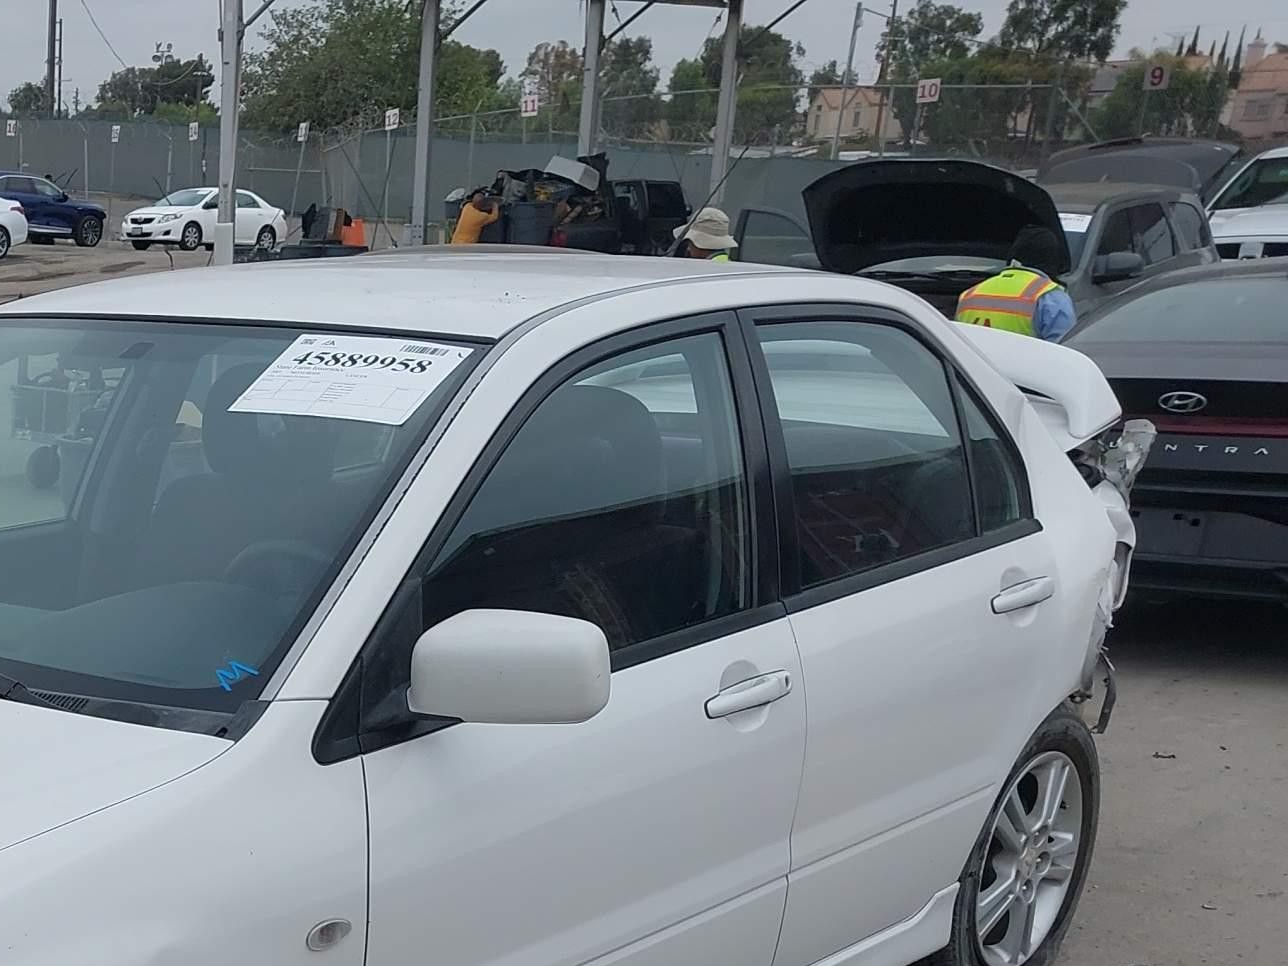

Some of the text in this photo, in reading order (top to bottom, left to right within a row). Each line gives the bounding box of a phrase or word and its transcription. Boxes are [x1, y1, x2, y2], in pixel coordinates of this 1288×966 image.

[1150, 66, 1164, 87] 9
[919, 82, 938, 99] 10
[523, 99, 537, 113] 11
[386, 112, 398, 127] 12
[292, 350, 433, 374] 45889958
